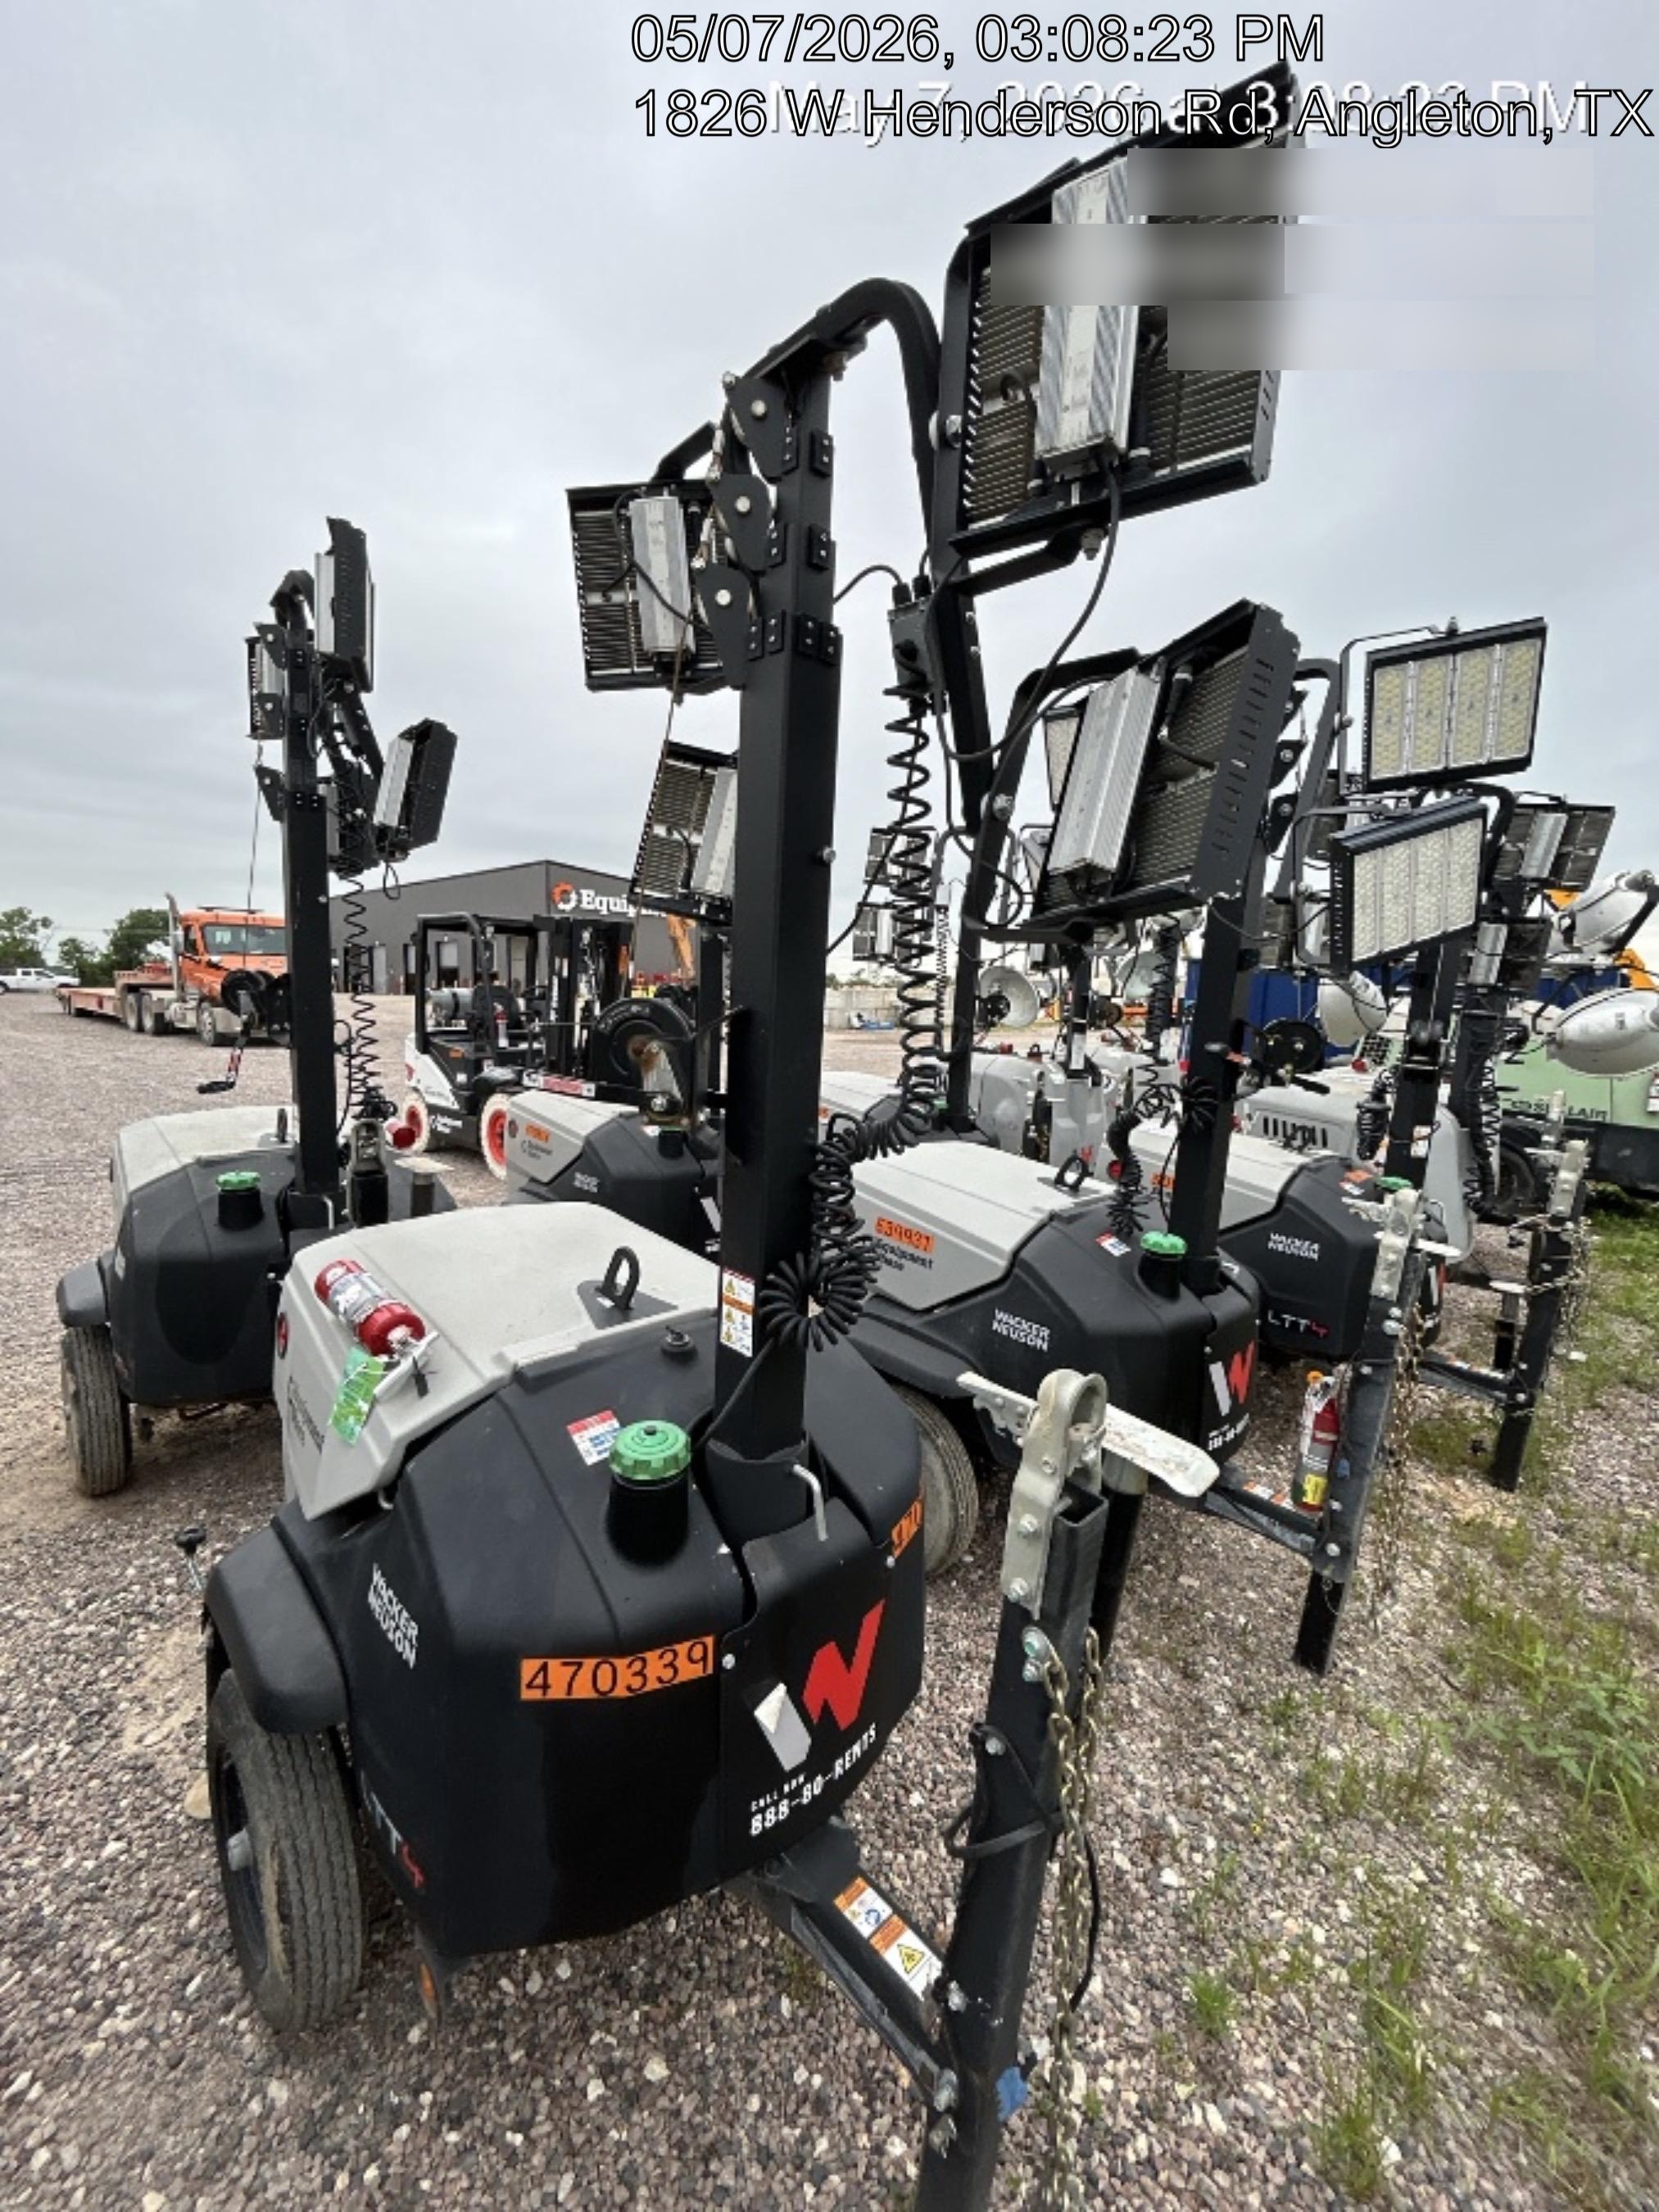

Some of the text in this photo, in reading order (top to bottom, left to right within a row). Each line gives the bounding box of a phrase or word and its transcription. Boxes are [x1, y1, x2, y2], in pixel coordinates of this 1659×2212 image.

[992, 1320, 1048, 1353] NEUSON
[995, 1308, 1050, 1341] WACKER
[372, 1562, 419, 1646] WACKER
[524, 1640, 709, 1698] 470339
